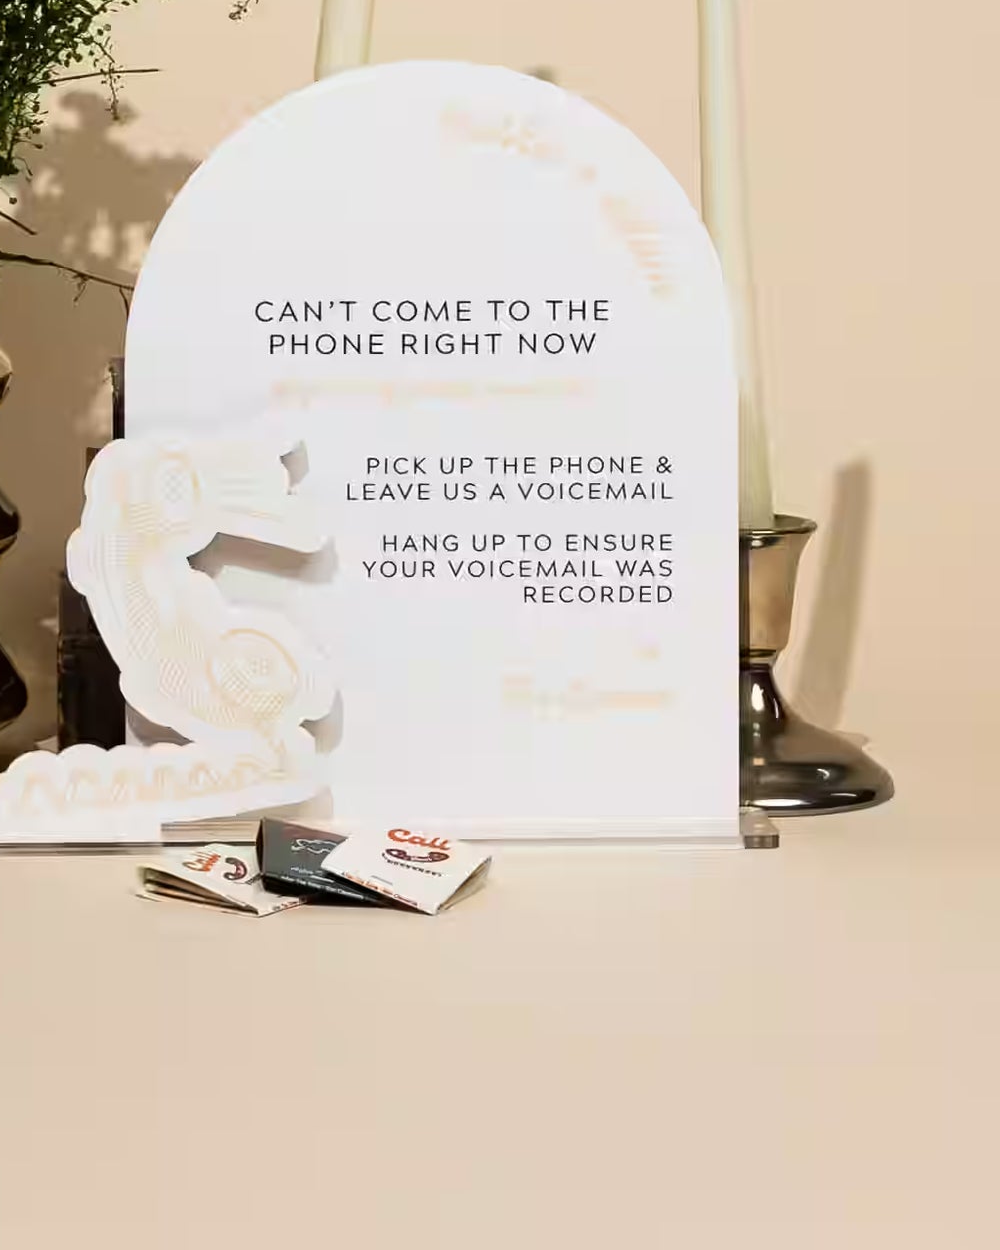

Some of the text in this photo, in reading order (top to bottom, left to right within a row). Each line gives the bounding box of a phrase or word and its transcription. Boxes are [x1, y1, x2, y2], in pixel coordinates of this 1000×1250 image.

[254, 299, 609, 323] CAN’T COME TO THE
[269, 332, 596, 355] PHONE RIGHT NOW
[367, 456, 672, 475] PICK UP THE PHONE &
[346, 482, 673, 501] LEAVE US A VOICEMAIL
[382, 533, 672, 552] HANG UP TO ENSURE
[362, 559, 673, 578] YOUR VOICEMAIL WAS
[523, 585, 673, 604] RECORDED
[388, 828, 451, 851] Call
